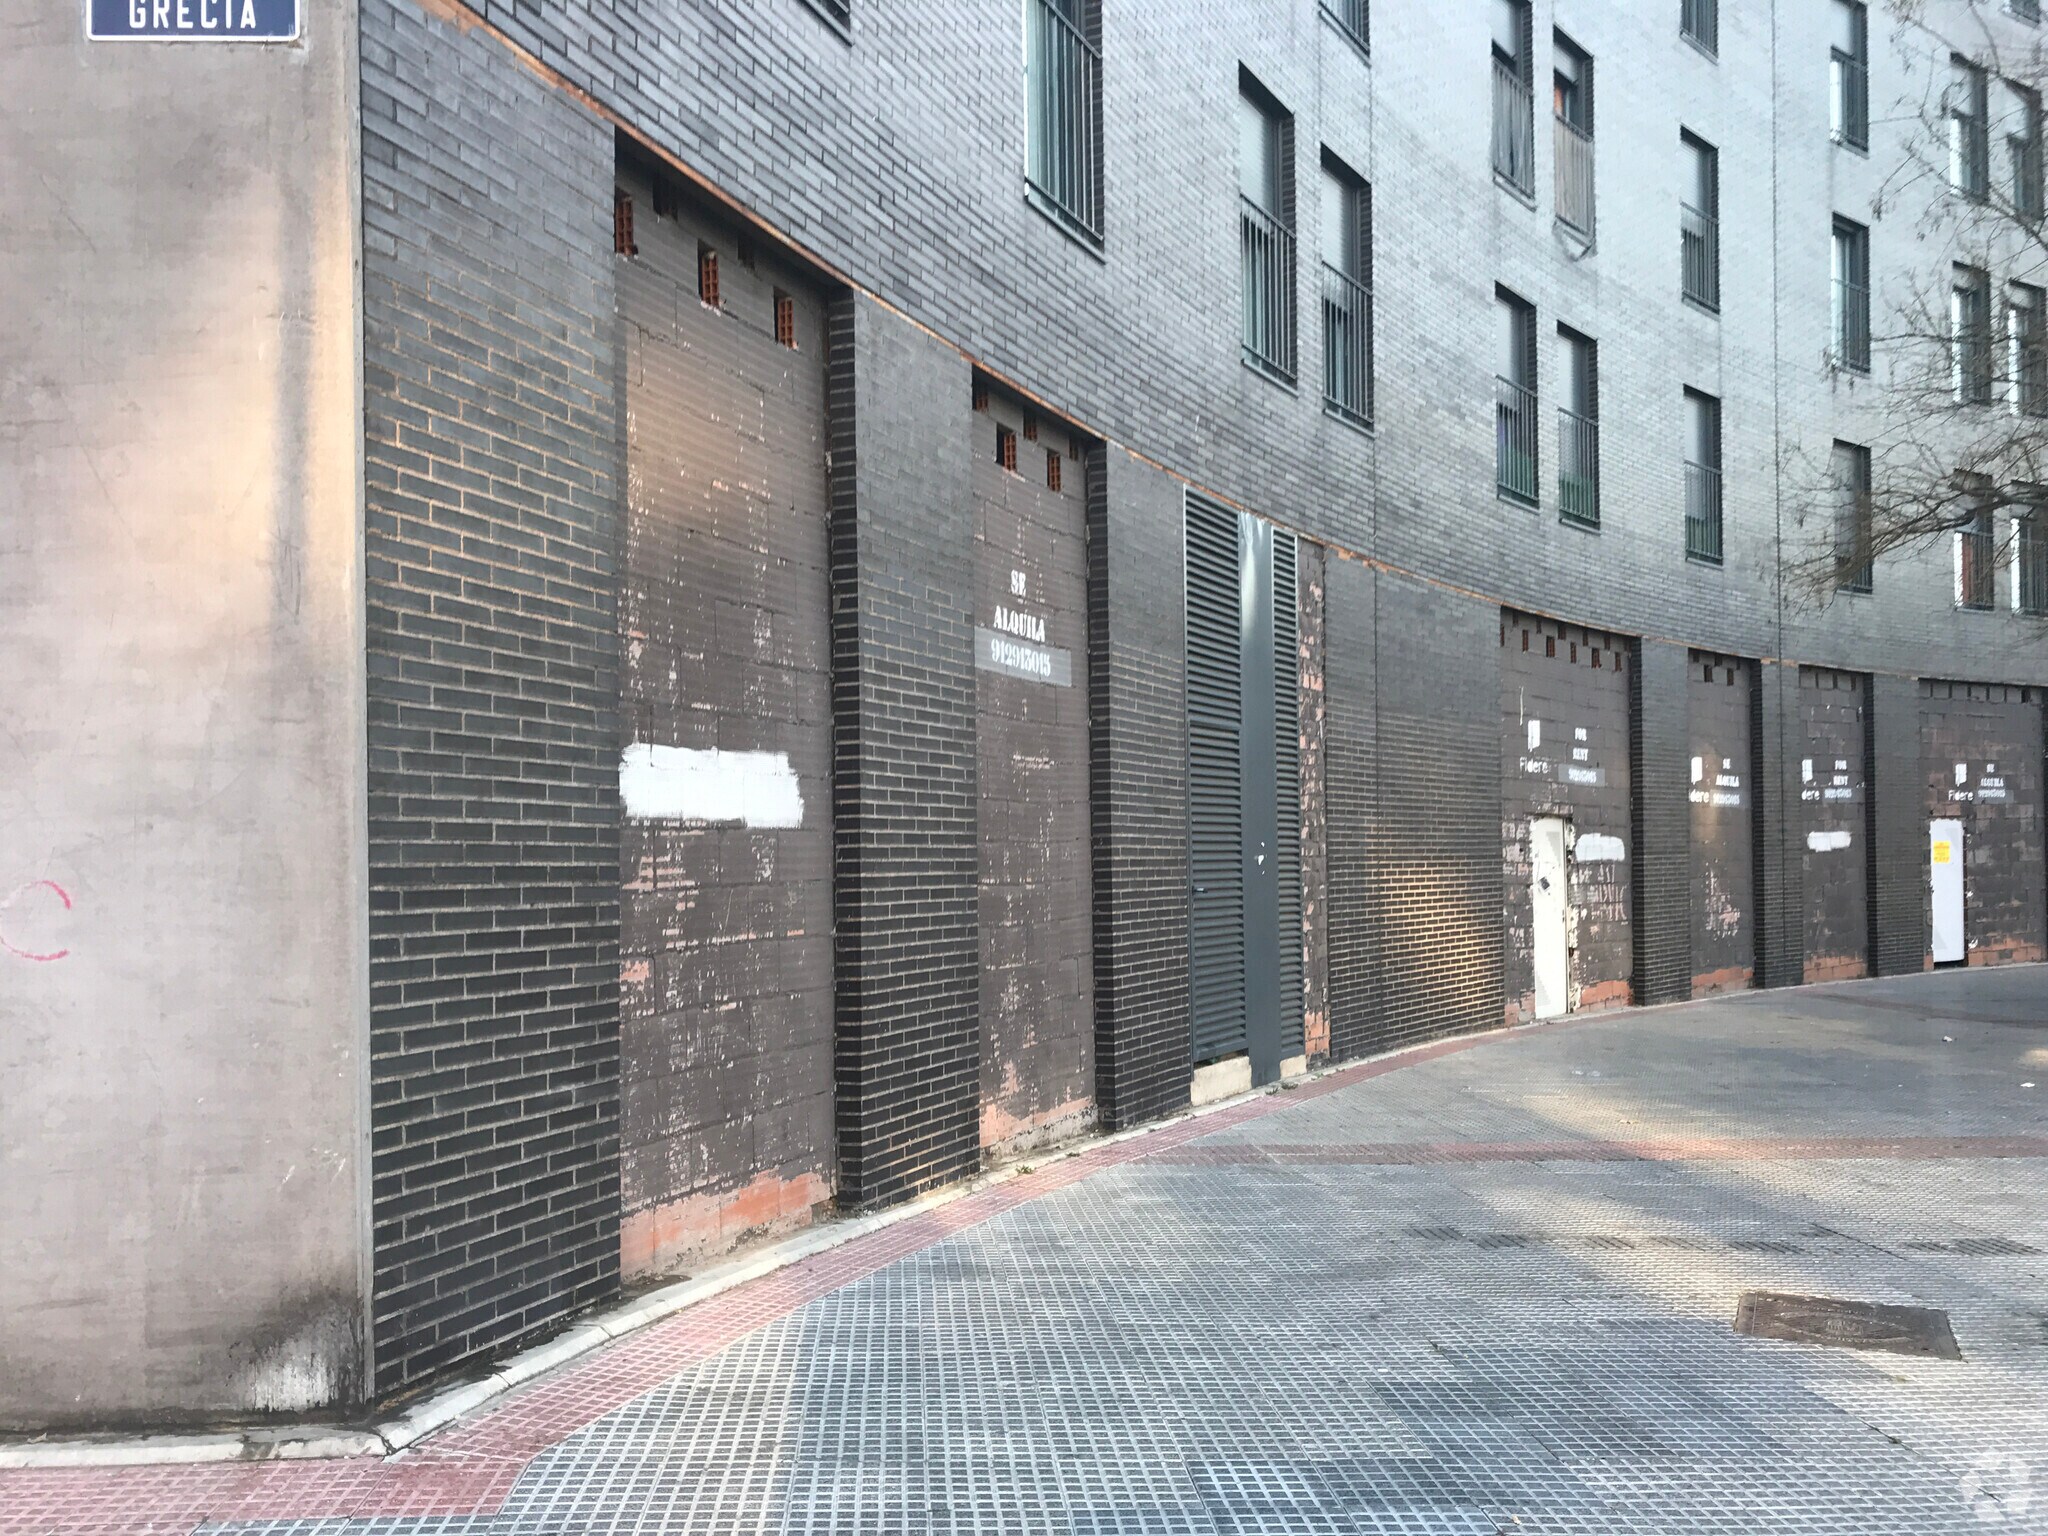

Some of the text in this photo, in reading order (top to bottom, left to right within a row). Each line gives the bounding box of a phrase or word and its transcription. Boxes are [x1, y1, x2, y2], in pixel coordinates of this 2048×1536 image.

[129, 0, 257, 29] GRECIA
[1010, 569, 1027, 597] SE
[993, 605, 1046, 642] ALQUILA
[1575, 727, 1587, 742] FOR
[1572, 747, 1588, 762] RENT
[1519, 756, 1549, 774] Fidere
[1948, 789, 1974, 801] Fidere
